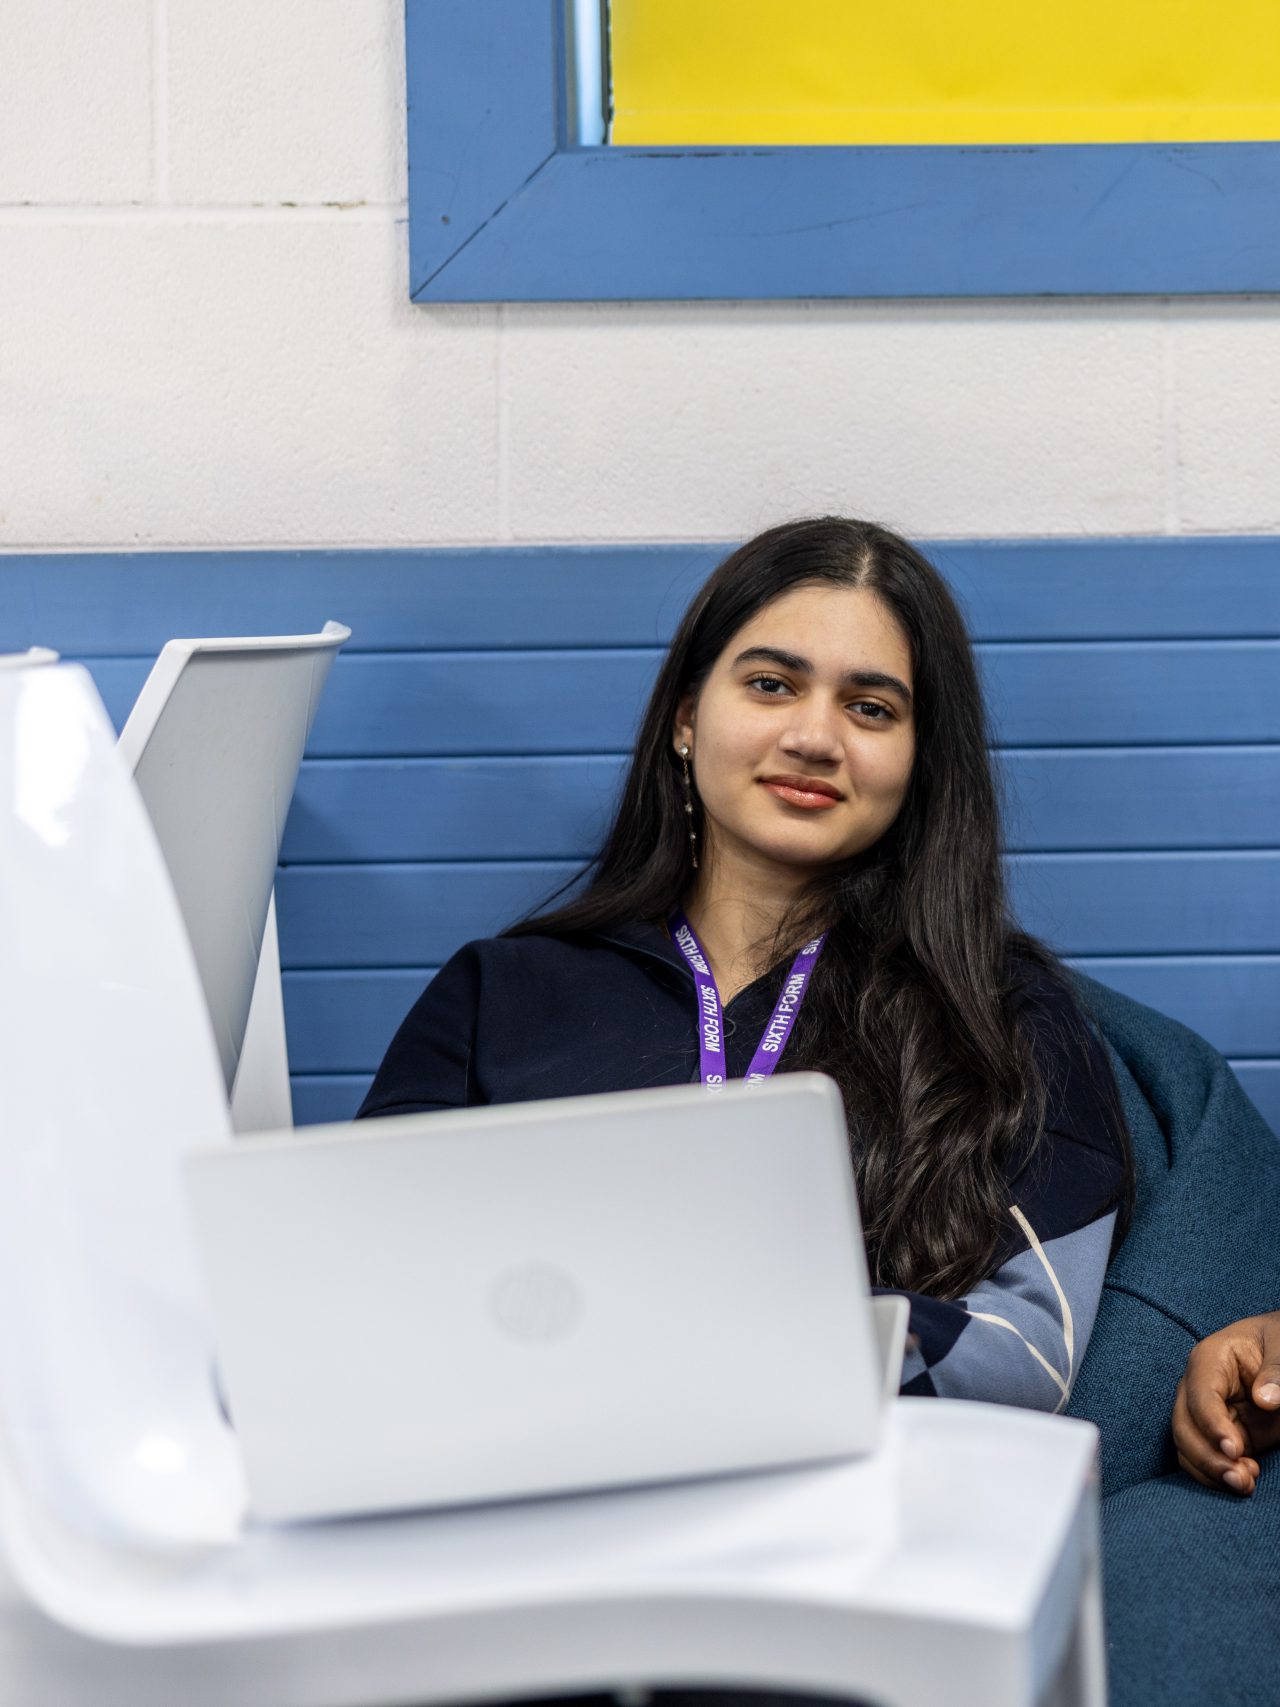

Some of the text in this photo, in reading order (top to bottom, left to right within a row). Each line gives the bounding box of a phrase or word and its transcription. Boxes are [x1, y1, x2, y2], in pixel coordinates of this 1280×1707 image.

[675, 925, 699, 960] SIXTH
[700, 984, 721, 1053] SIXTH FORM
[762, 973, 806, 1053] SIXTH FORM
